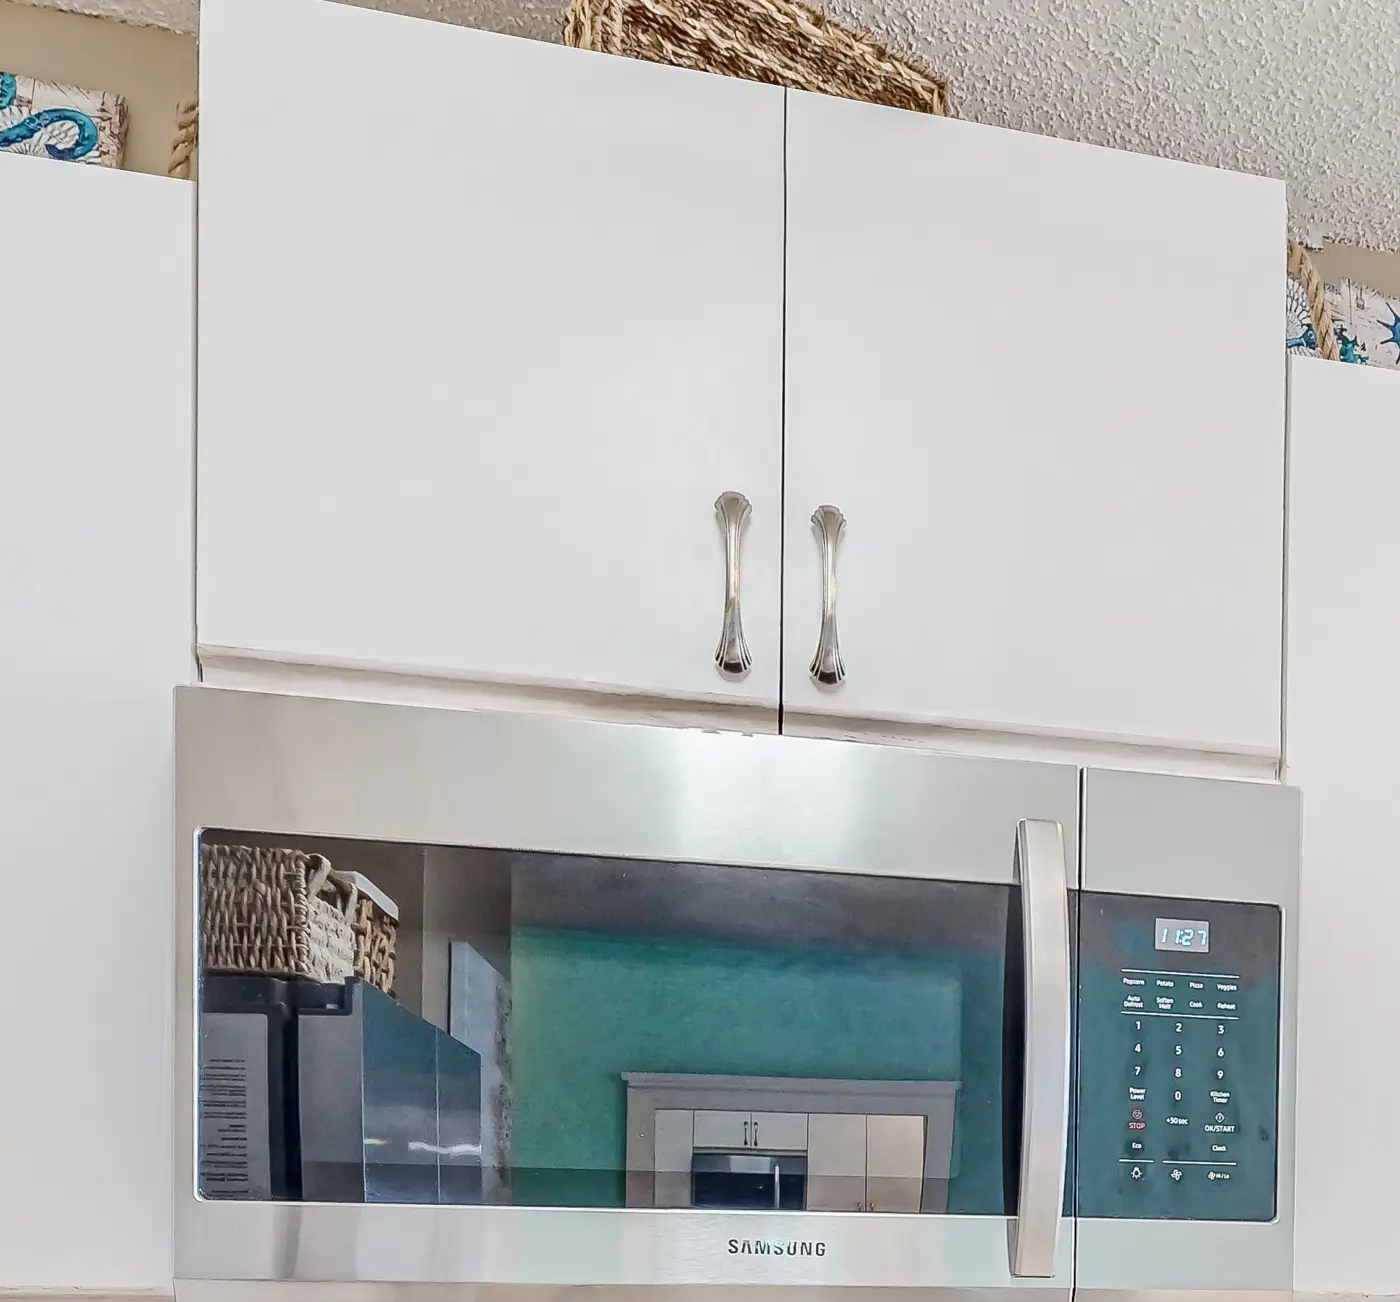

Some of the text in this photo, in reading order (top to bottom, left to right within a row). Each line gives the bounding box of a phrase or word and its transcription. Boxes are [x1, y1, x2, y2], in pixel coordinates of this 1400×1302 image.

[1162, 928, 1207, 946] 11:27
[1135, 1021, 1141, 1030] 1
[1176, 1023, 1182, 1032] 2
[1217, 1025, 1224, 1034] 3
[1135, 1044, 1141, 1052] 4
[1176, 1046, 1182, 1054] 5
[1217, 1048, 1224, 1057] 6
[1135, 1067, 1141, 1075] 7
[1175, 1068, 1182, 1078] 8
[1217, 1070, 1223, 1079] 9
[1175, 1091, 1181, 1100] 0
[728, 1239, 826, 1256] SAMSUNG
